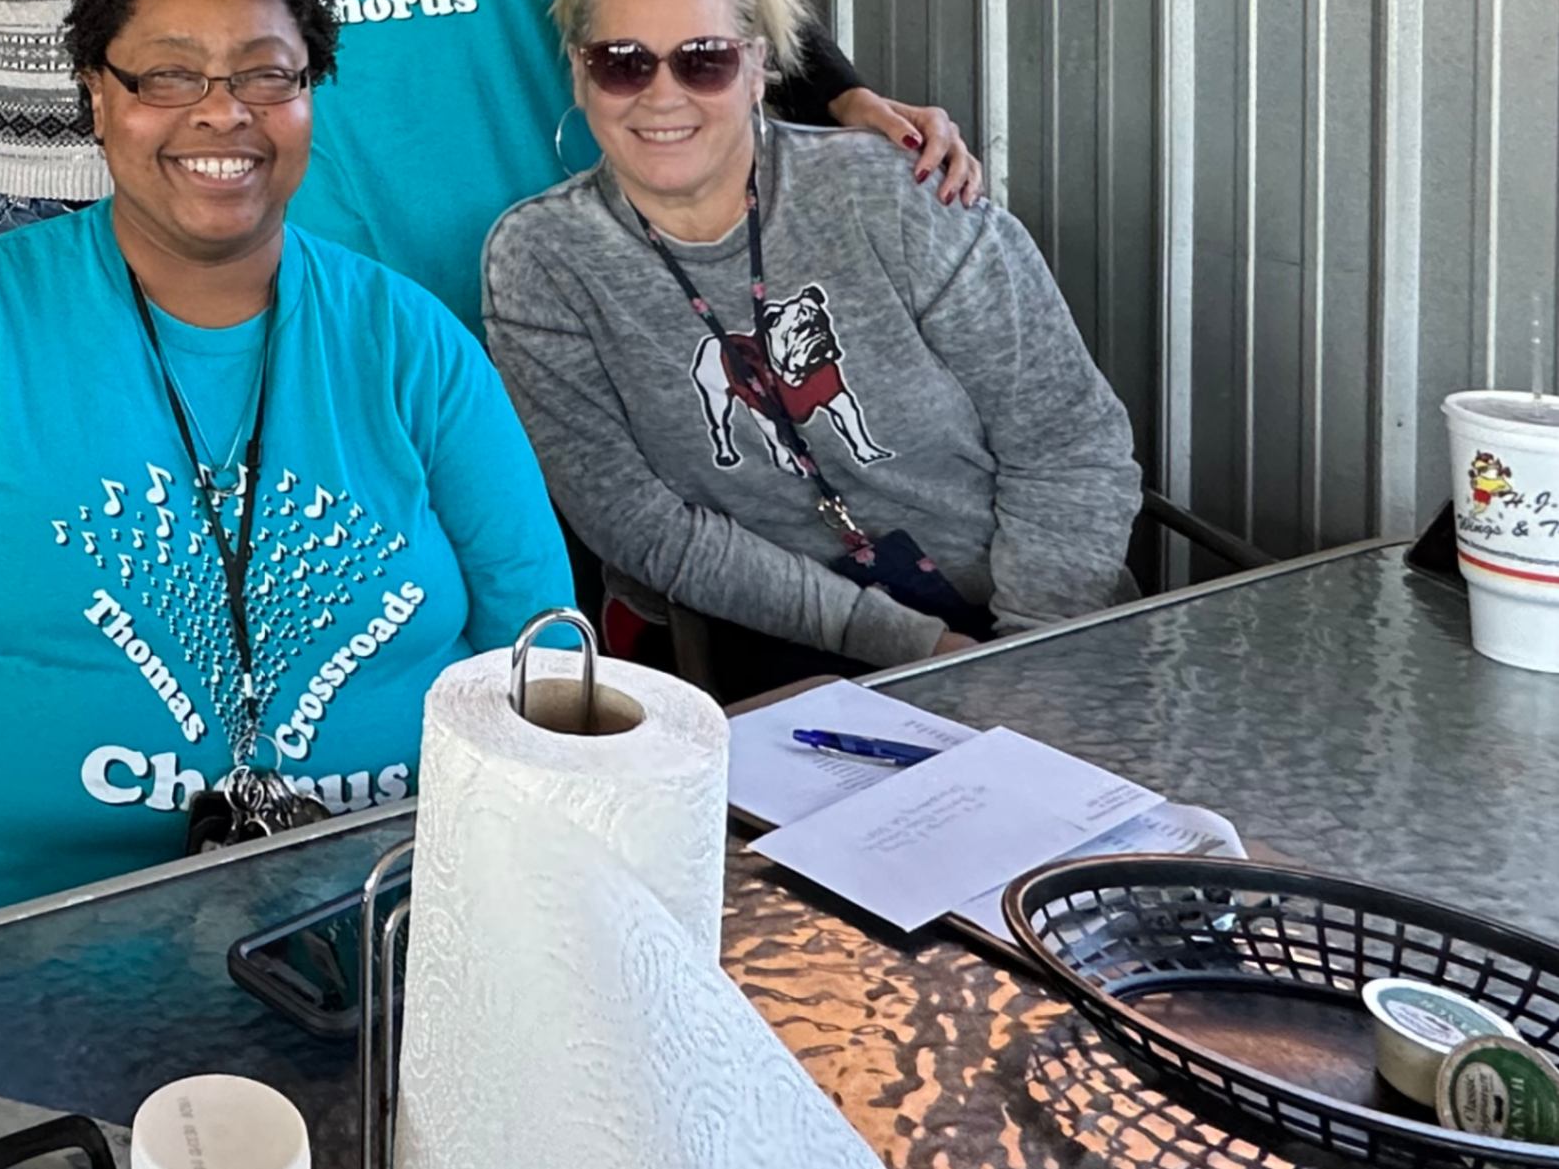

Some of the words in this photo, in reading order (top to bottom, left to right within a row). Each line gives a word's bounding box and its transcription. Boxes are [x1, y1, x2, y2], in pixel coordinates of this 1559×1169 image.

[1511, 520, 1530, 537] &
[84, 588, 209, 743] Thomas
[275, 580, 426, 760] Crossroads
[81, 744, 410, 815] Chrus
